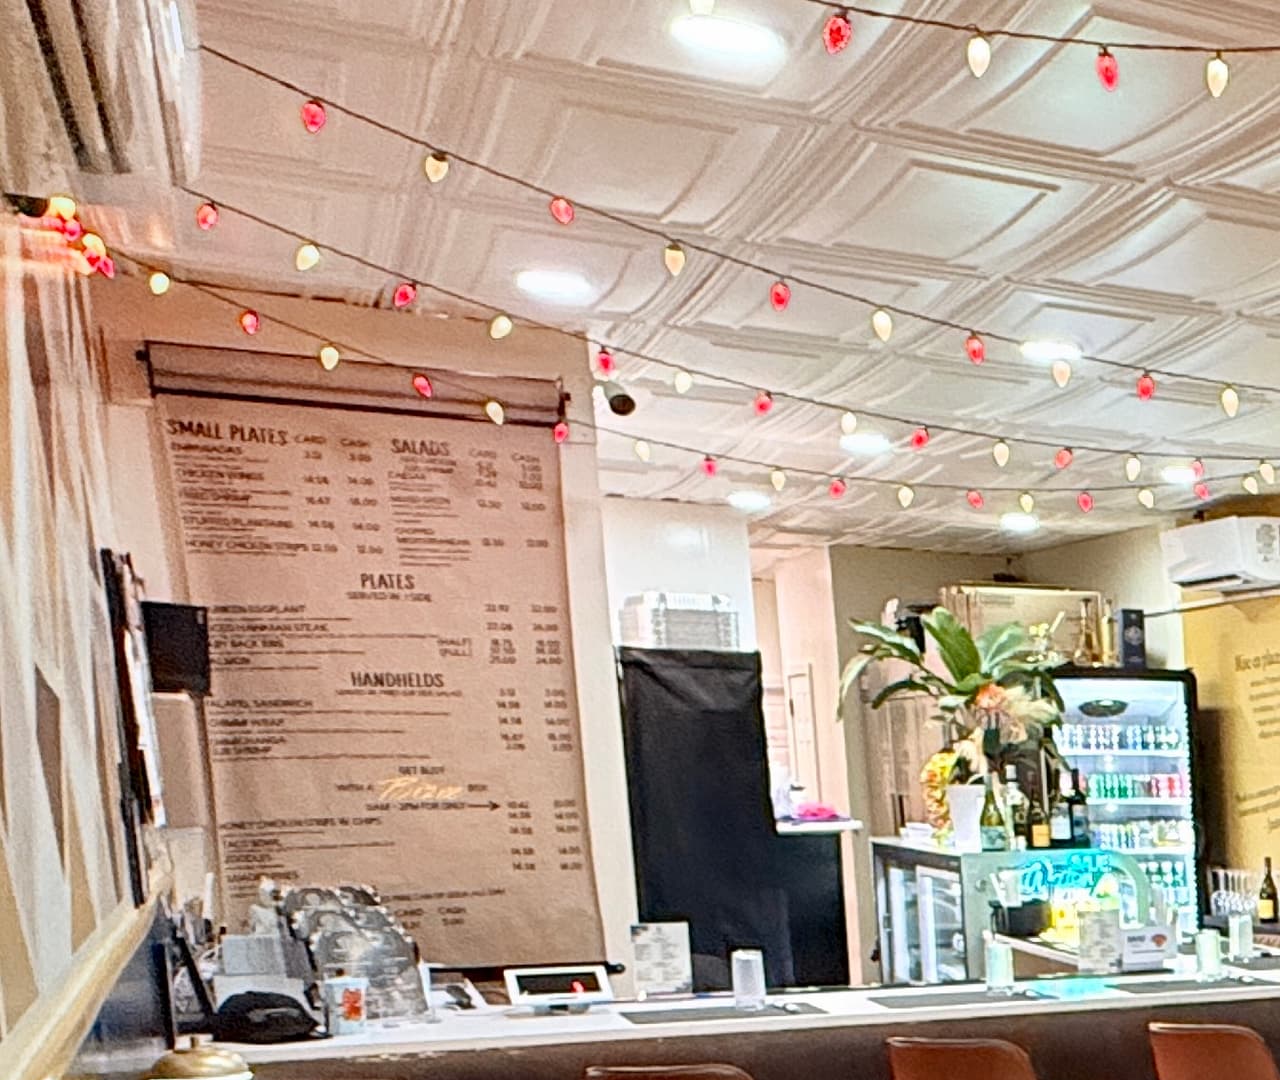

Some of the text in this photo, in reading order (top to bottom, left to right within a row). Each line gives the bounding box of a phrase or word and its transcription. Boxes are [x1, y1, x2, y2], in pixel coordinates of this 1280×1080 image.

[166, 418, 223, 440] SMALL
[229, 424, 288, 446] PLATES
[391, 438, 450, 457] SALADS
[360, 573, 415, 590] PLATES
[350, 671, 445, 688] HANDHELDS
